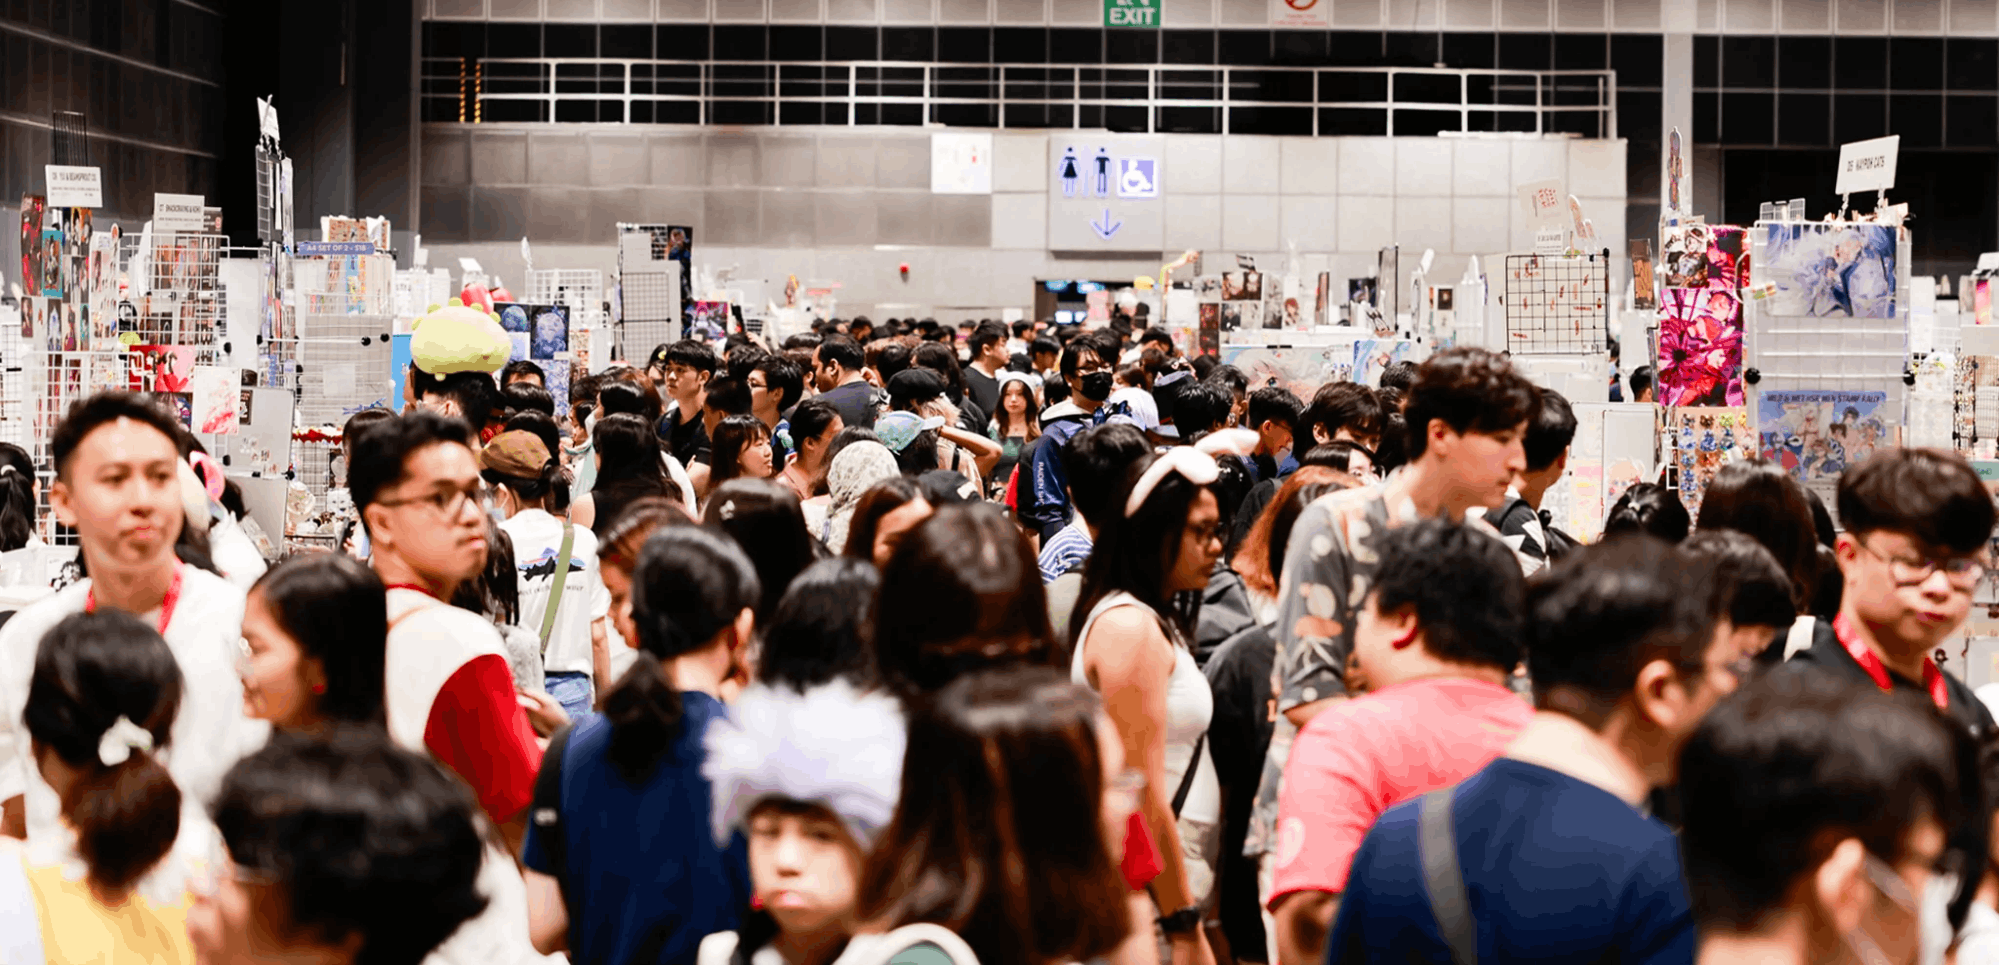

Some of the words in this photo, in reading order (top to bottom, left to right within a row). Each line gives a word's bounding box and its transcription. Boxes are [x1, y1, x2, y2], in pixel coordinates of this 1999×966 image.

[1110, 7, 1155, 25] EXIT
[1837, 394, 1861, 402] STAMP
[1861, 394, 1881, 402] RALLY
[1037, 461, 1045, 489] RAIDEN
